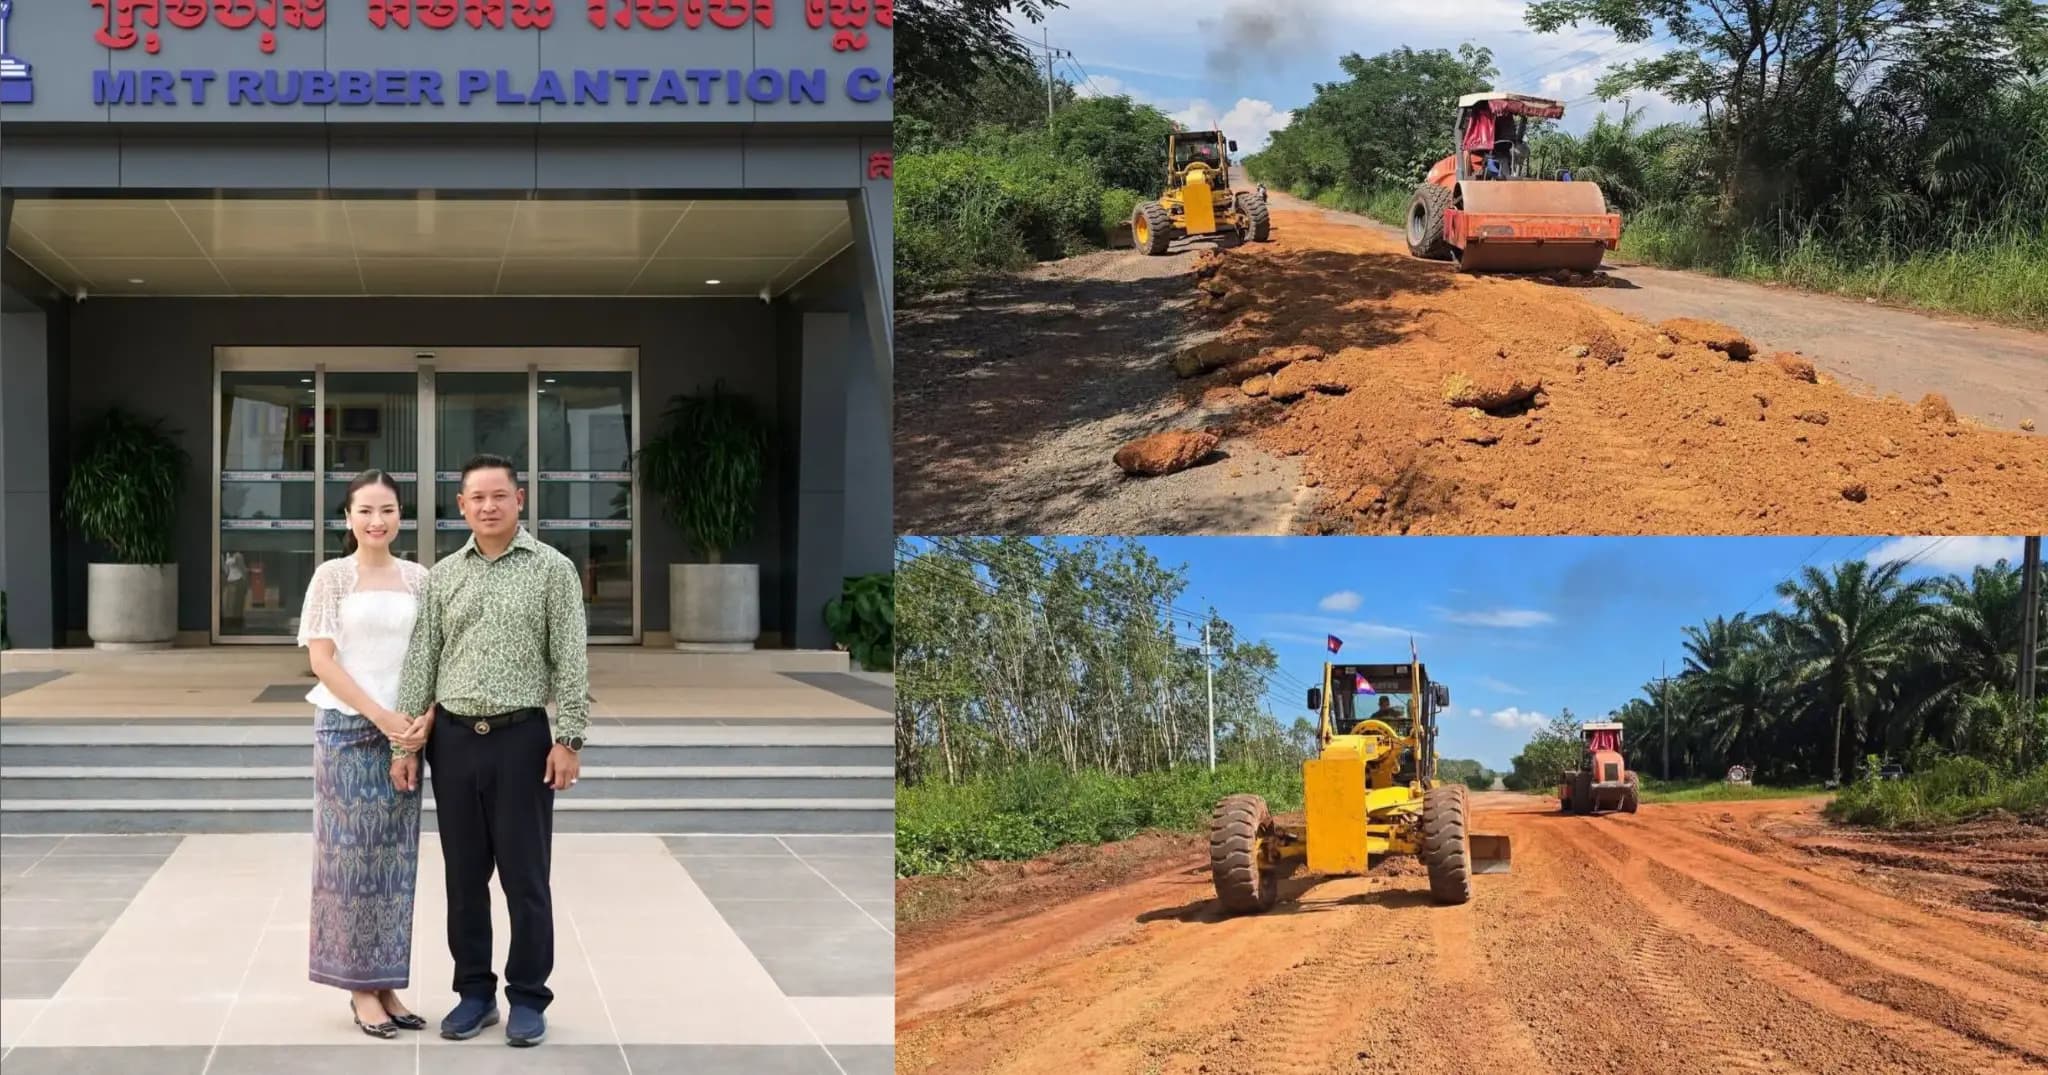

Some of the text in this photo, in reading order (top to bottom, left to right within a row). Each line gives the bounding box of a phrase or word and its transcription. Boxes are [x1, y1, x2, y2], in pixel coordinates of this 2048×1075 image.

[92, 67, 893, 105] MRT RUBBER PLANTATION C
